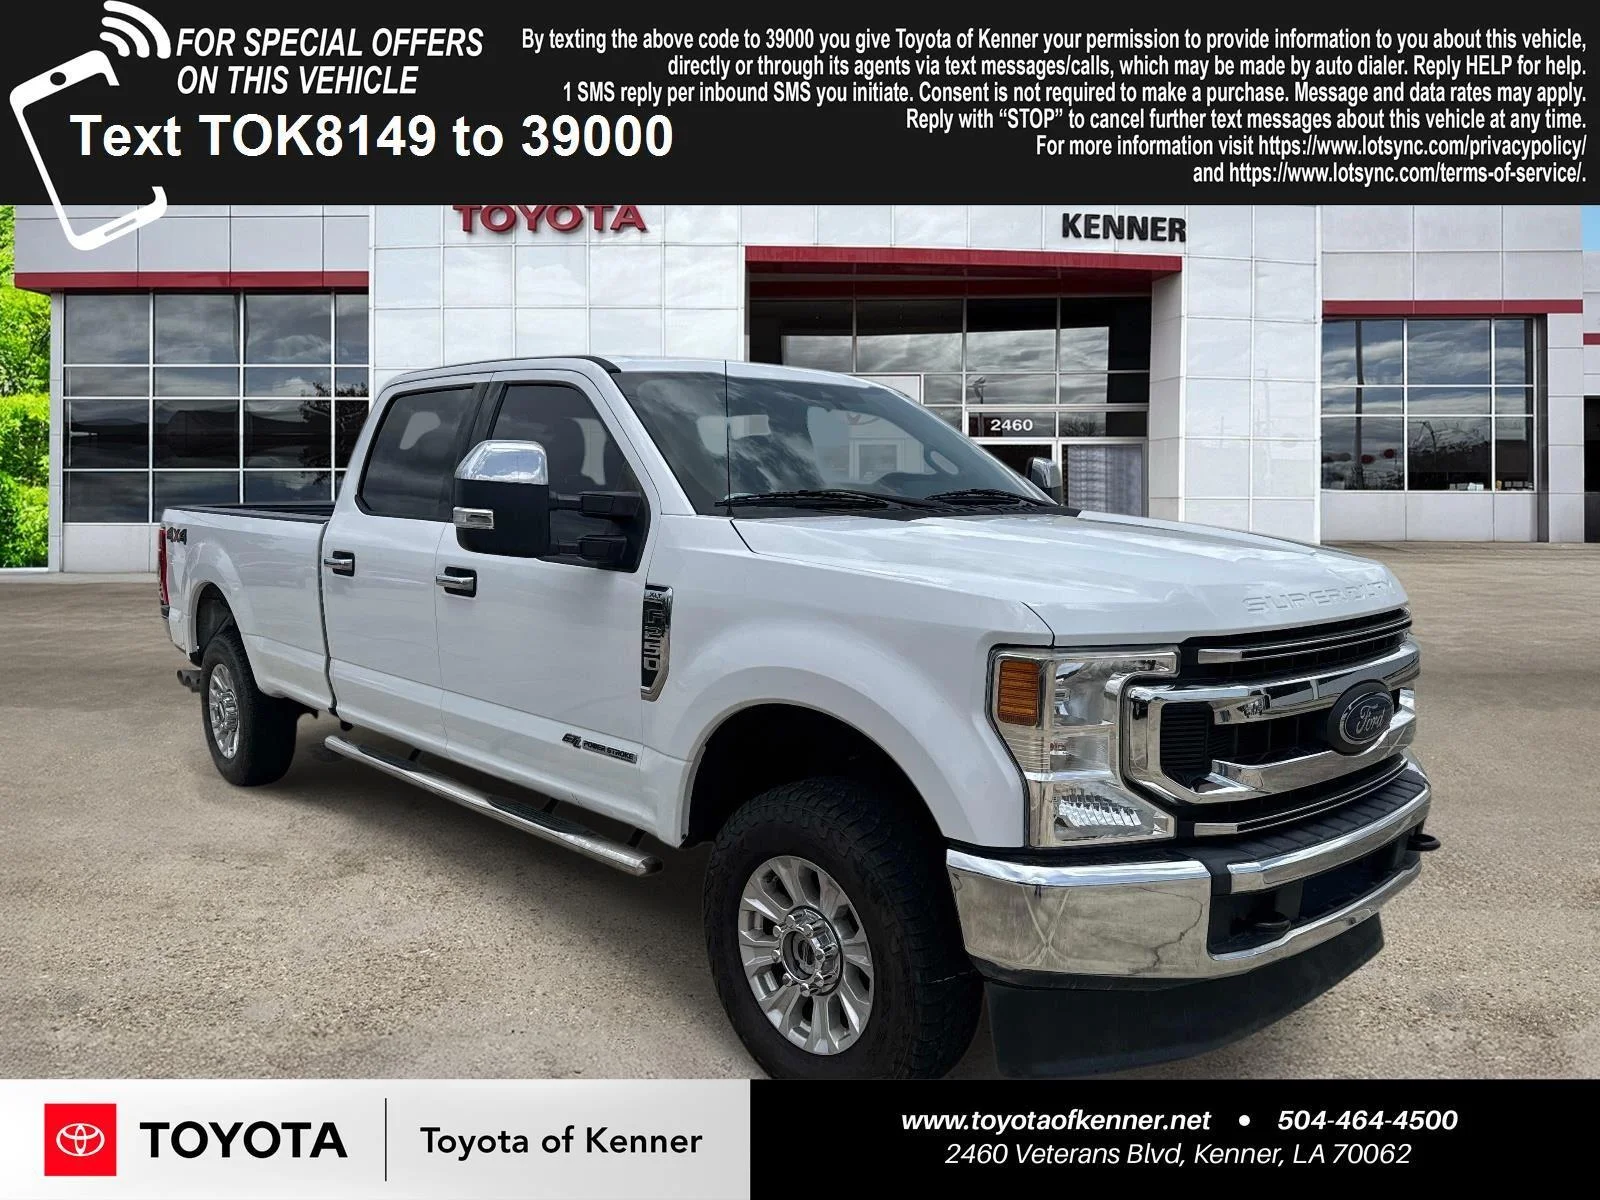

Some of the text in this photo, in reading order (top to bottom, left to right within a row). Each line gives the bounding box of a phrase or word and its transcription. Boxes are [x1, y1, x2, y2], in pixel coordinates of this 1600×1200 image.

[453, 205, 647, 233] TOYOTA
[1062, 213, 1187, 243] KENNER
[990, 418, 1034, 432] 2460
[1242, 588, 1344, 614] SUPER
[1355, 705, 1387, 734] Ford
[583, 740, 606, 753] POWER
[606, 747, 635, 760] STROKE
